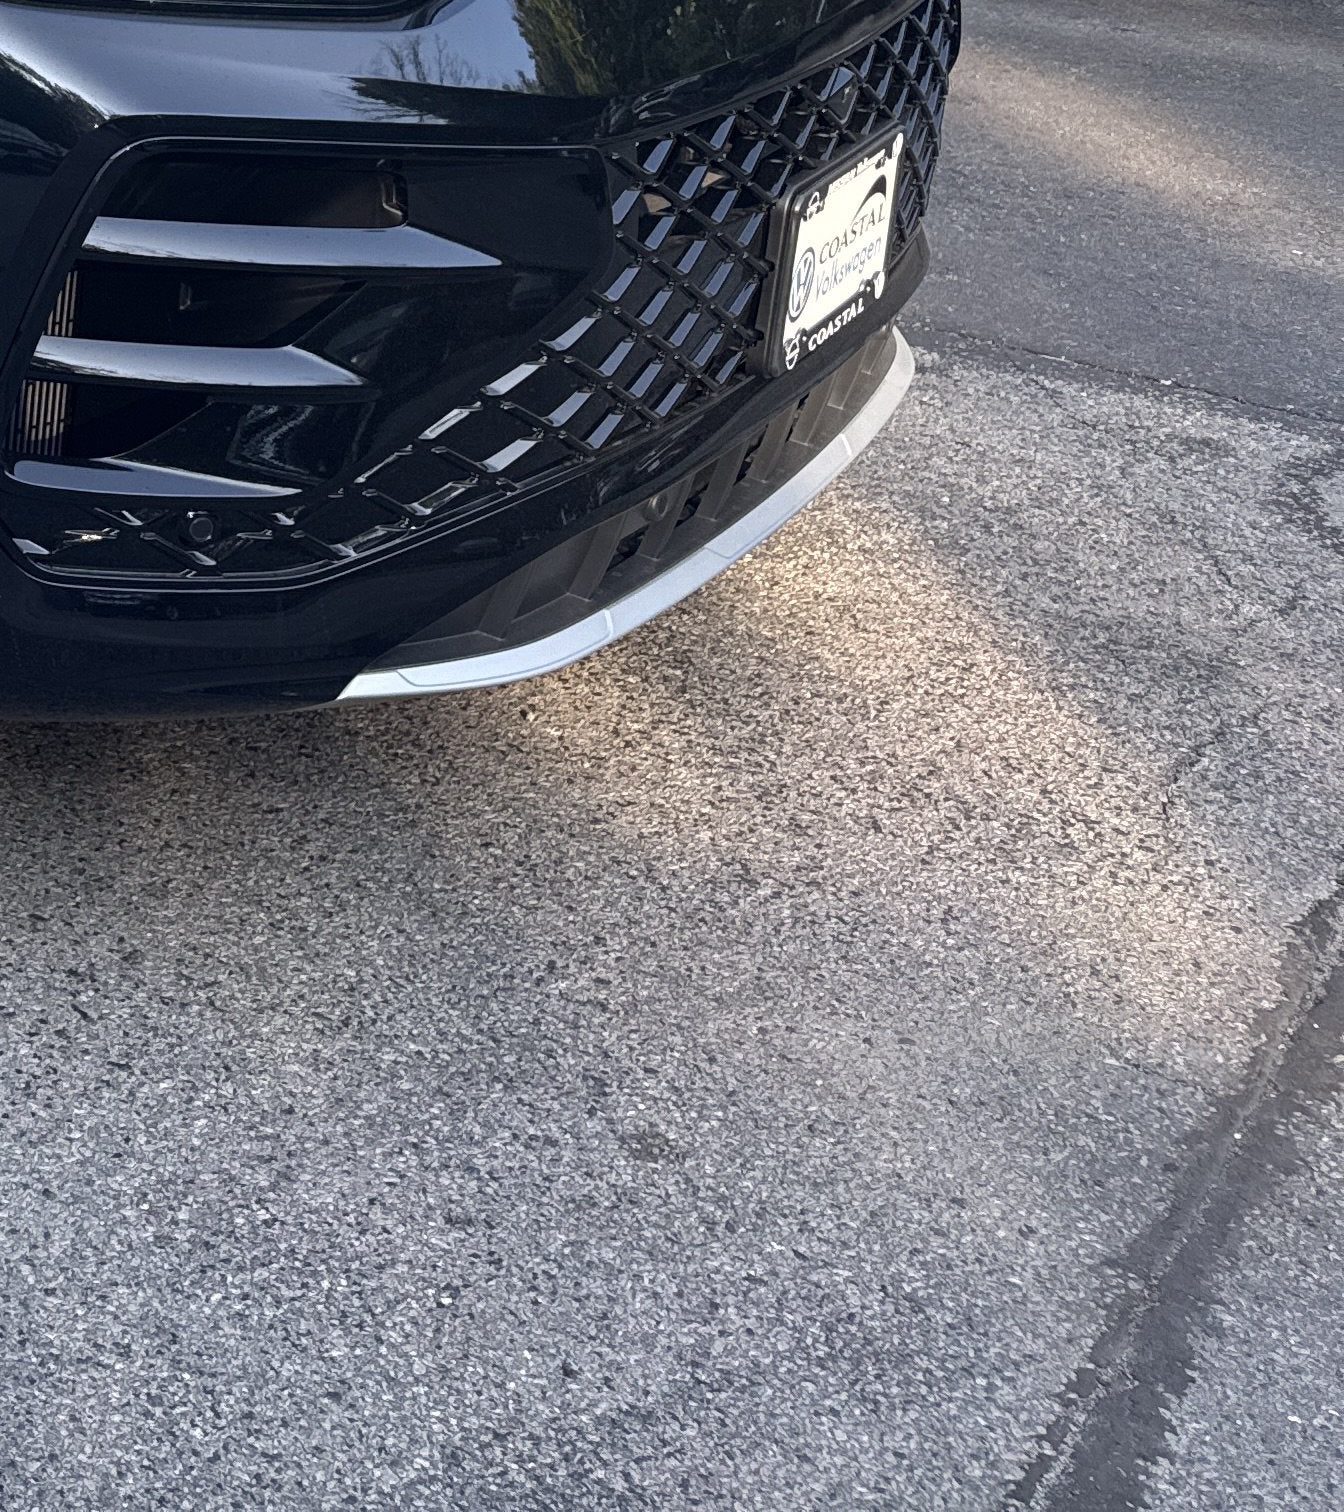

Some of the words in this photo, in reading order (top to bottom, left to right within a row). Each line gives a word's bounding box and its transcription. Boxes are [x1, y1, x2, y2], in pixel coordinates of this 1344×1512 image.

[819, 202, 885, 265] COASTAL
[816, 237, 882, 302] Volkswagen
[808, 297, 865, 351] COASTAL
